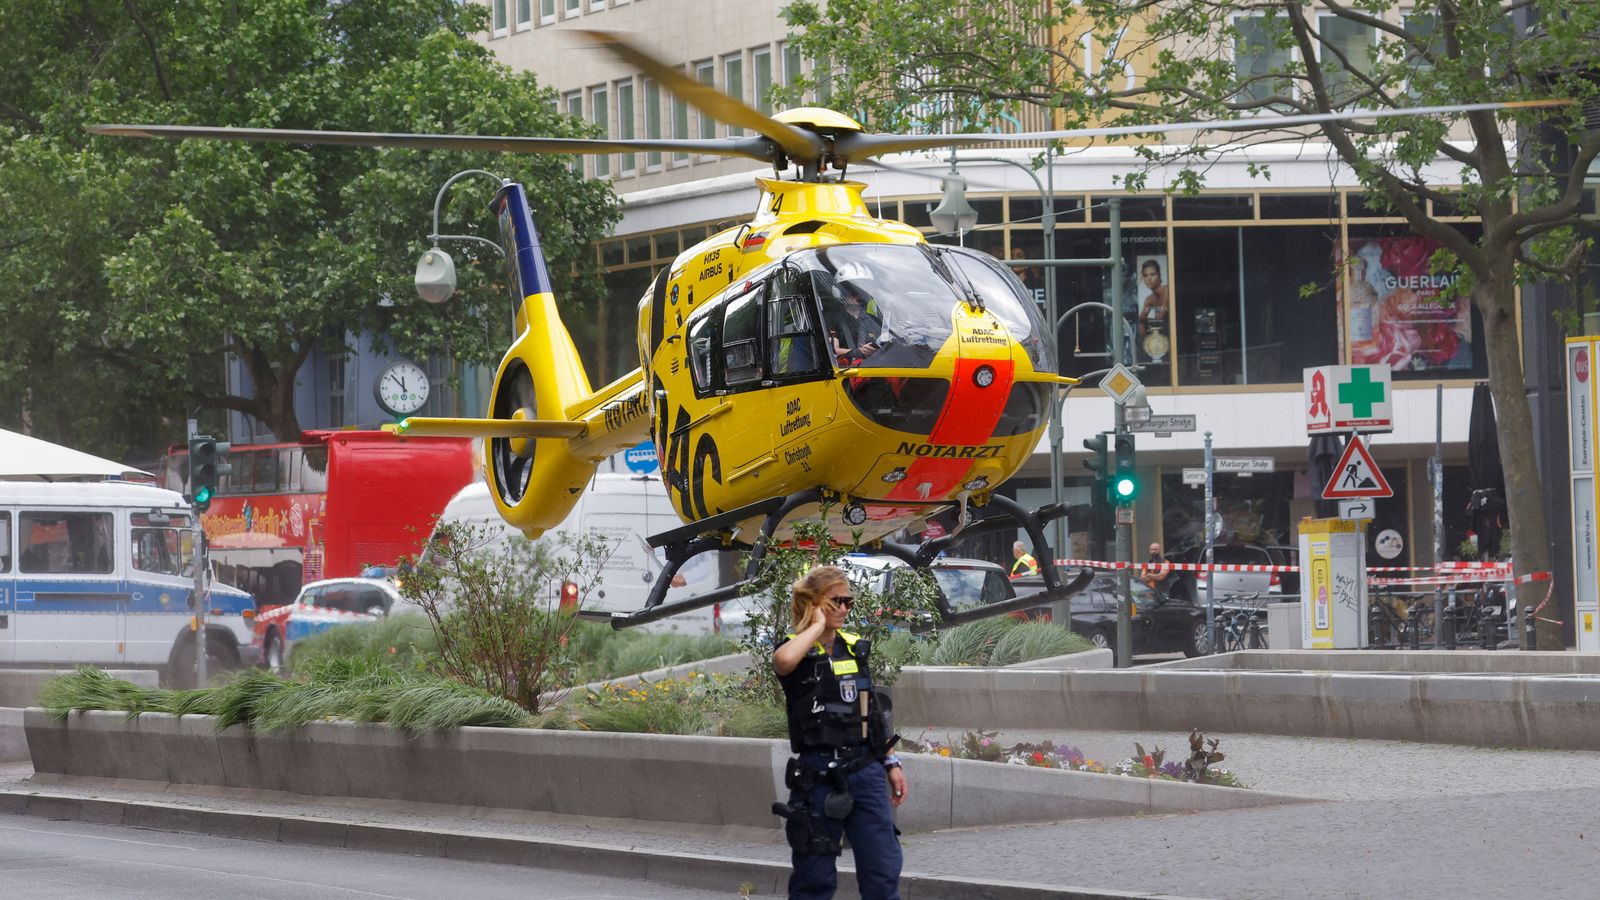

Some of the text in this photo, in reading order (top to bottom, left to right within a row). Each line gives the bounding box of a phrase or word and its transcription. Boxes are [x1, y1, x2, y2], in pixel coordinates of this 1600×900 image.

[704, 249, 720, 264] H135
[699, 263, 722, 281] AIRBUS
[972, 328, 995, 336] ADAC
[961, 335, 1008, 346] Luftrettung
[1576, 361, 1589, 373] BUS
[786, 397, 801, 417] ADAC
[780, 413, 811, 437] Luftrettung
[1170, 417, 1192, 428] Straße
[1580, 394, 1588, 465] Europa-Center
[785, 442, 812, 465] Christoph
[896, 441, 1006, 458] NOTARZT
[1220, 460, 1249, 468] Marburger
